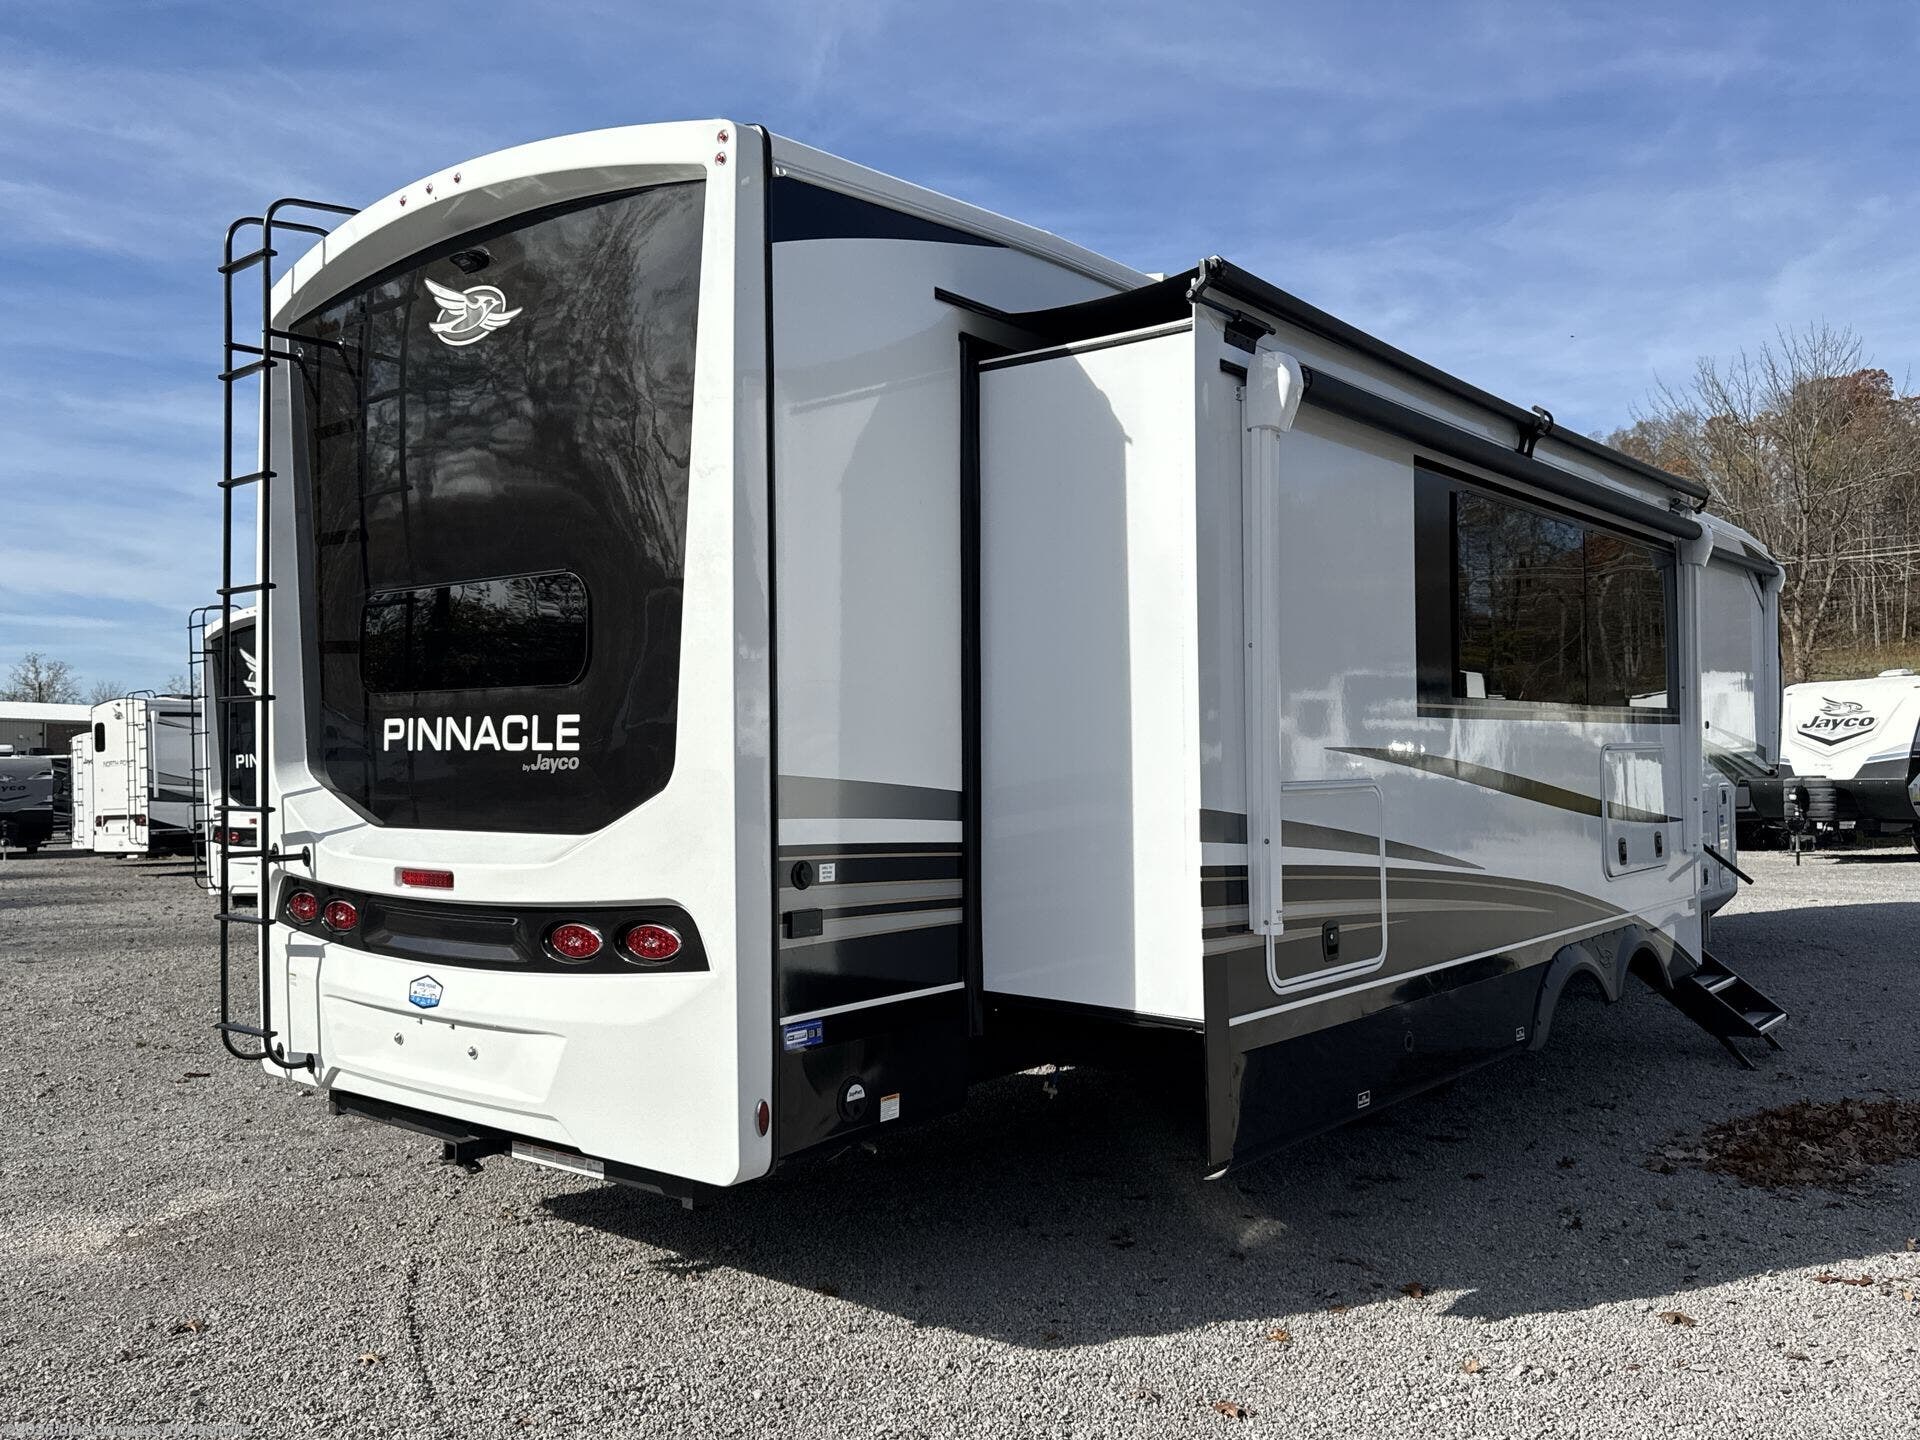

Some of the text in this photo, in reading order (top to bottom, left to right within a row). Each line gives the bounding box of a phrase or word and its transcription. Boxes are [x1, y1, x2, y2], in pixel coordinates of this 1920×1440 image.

[383, 713, 581, 751] PINNACLE
[1802, 715, 1875, 730] Jayco
[522, 753, 580, 773] by Jayco
